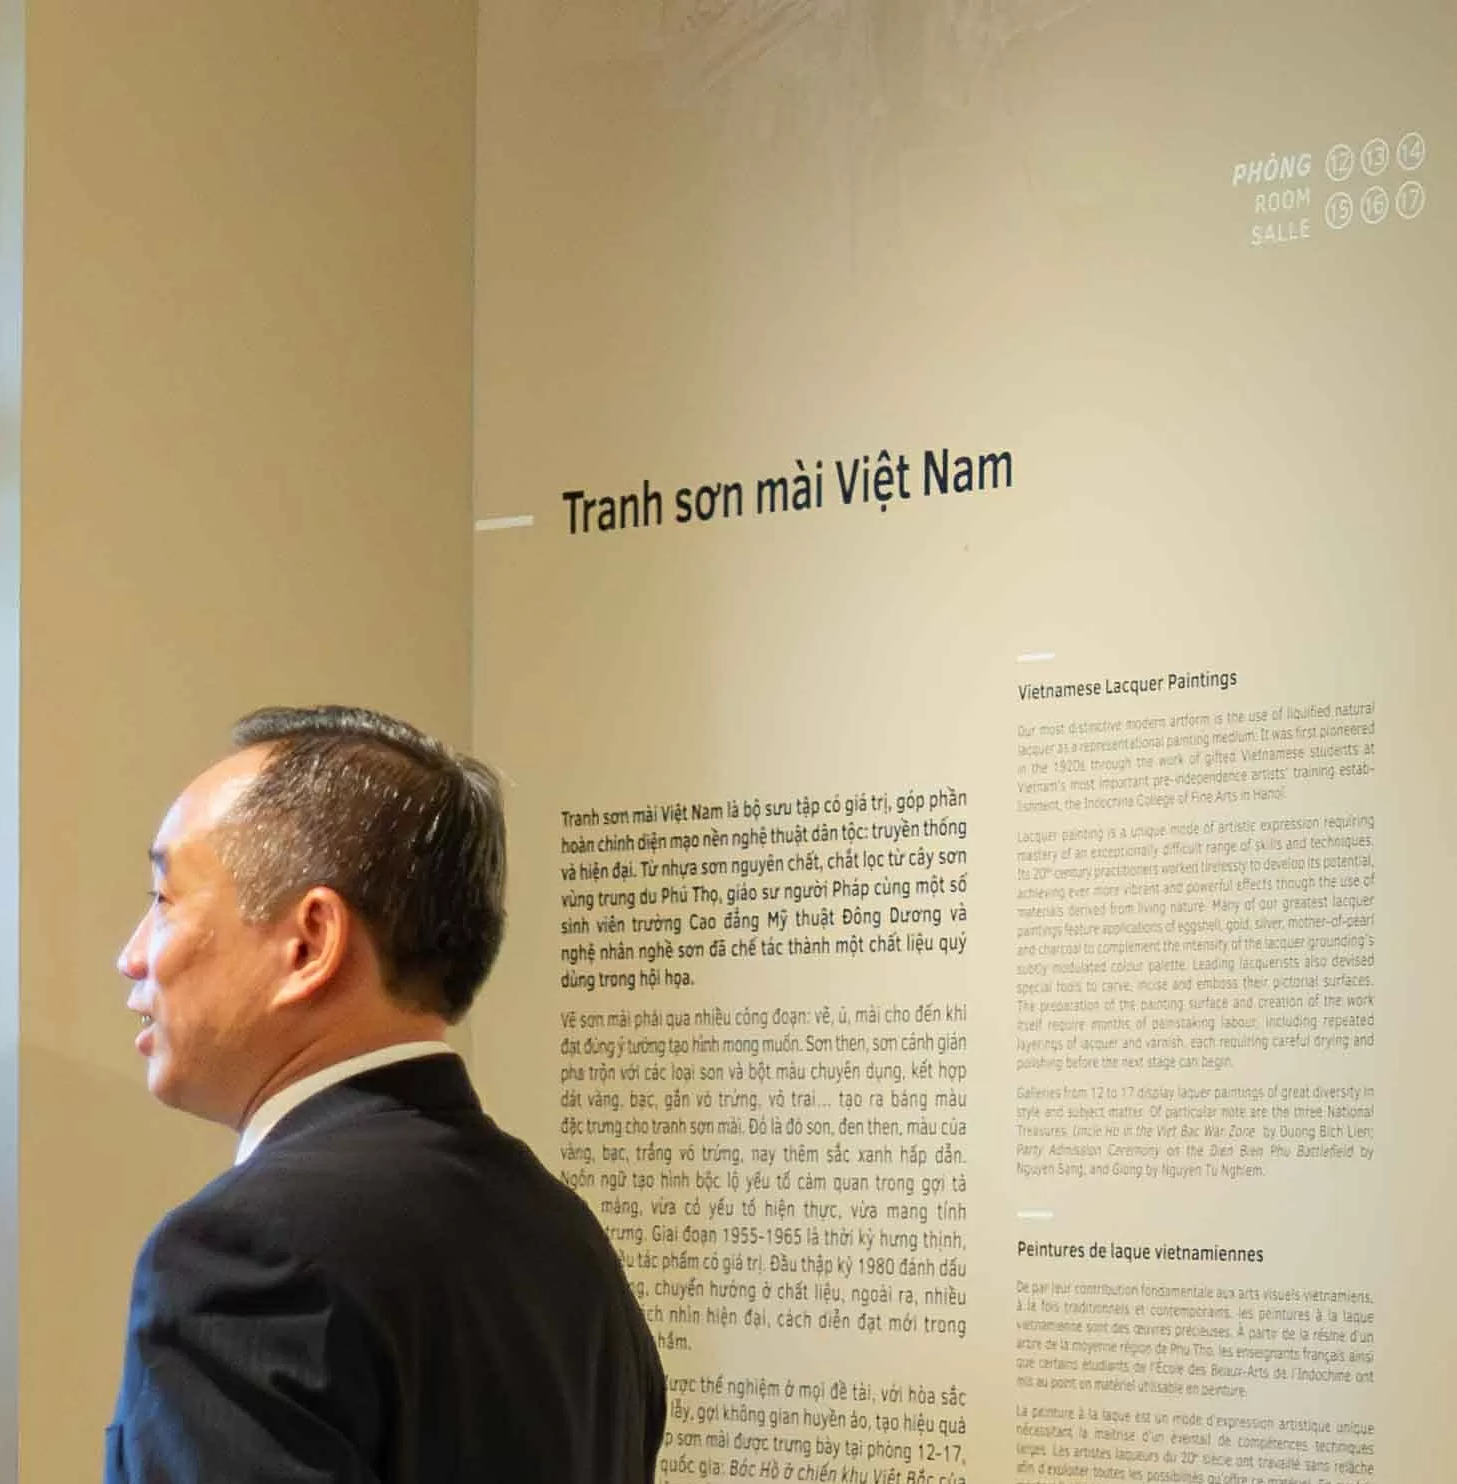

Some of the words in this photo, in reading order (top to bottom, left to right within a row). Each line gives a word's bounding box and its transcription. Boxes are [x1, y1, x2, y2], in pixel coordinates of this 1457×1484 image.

[1255, 188, 1310, 214] ROOM
[1250, 218, 1311, 246] SALLE
[562, 480, 663, 535] Tranh
[675, 483, 743, 523] sơn
[756, 458, 823, 514] mài
[835, 449, 910, 512] Việt
[923, 448, 1013, 497] Nam
[1017, 678, 1101, 700] Vietnamese
[1105, 674, 1164, 698] Lacquer
[1168, 668, 1237, 693] Paintings
[561, 809, 599, 826] Tranh
[603, 811, 629, 824] sơn
[691, 803, 723, 819] Nam
[743, 800, 761, 821] bộ
[765, 803, 791, 815] sưu
[796, 796, 819, 818] tập
[823, 795, 841, 812] có
[845, 794, 867, 816] giá
[871, 793, 891, 814] trị,
[669, 835, 699, 852] mạo
[702, 827, 728, 846] nền
[731, 827, 767, 849] nghệ
[770, 825, 807, 847] thuật
[841, 822, 868, 843] tộc:
[871, 817, 919, 842] truyền
[579, 862, 608, 883] hiện
[611, 861, 637, 882] đại.
[701, 861, 727, 874] sơn
[731, 854, 783, 877] nguyên
[863, 850, 884, 871] lọc
[938, 851, 966, 863] sơn
[598, 890, 635, 910] trung
[639, 888, 657, 904] du
[692, 885, 722, 906] Thọ,
[761, 887, 780, 899] sư
[783, 880, 827, 903] người
[832, 879, 869, 901] Pháp
[915, 876, 945, 897] một
[949, 873, 967, 892] số
[561, 917, 589, 934] sinh
[689, 914, 716, 929] Cao
[795, 908, 834, 930] thuật
[842, 907, 881, 928] Đông
[890, 906, 941, 927] Dương
[561, 943, 595, 965] nghệ
[599, 942, 634, 959] nhân
[638, 939, 674, 963] nghề
[677, 945, 704, 957] sơn
[709, 940, 726, 956] đã
[731, 936, 756, 955] chế
[761, 938, 783, 955] tác
[835, 936, 863, 957] một
[869, 932, 901, 952] chất
[906, 934, 933, 954] liệu
[598, 971, 635, 991] trong
[639, 969, 660, 989] hội
[664, 968, 694, 989] họa.
[723, 1228, 801, 1243] 1955-1965
[1017, 1240, 1084, 1257] Peintures
[1089, 1242, 1106, 1258] de
[1110, 1242, 1150, 1263] laque
[1154, 1243, 1263, 1261] vietnamiennes
